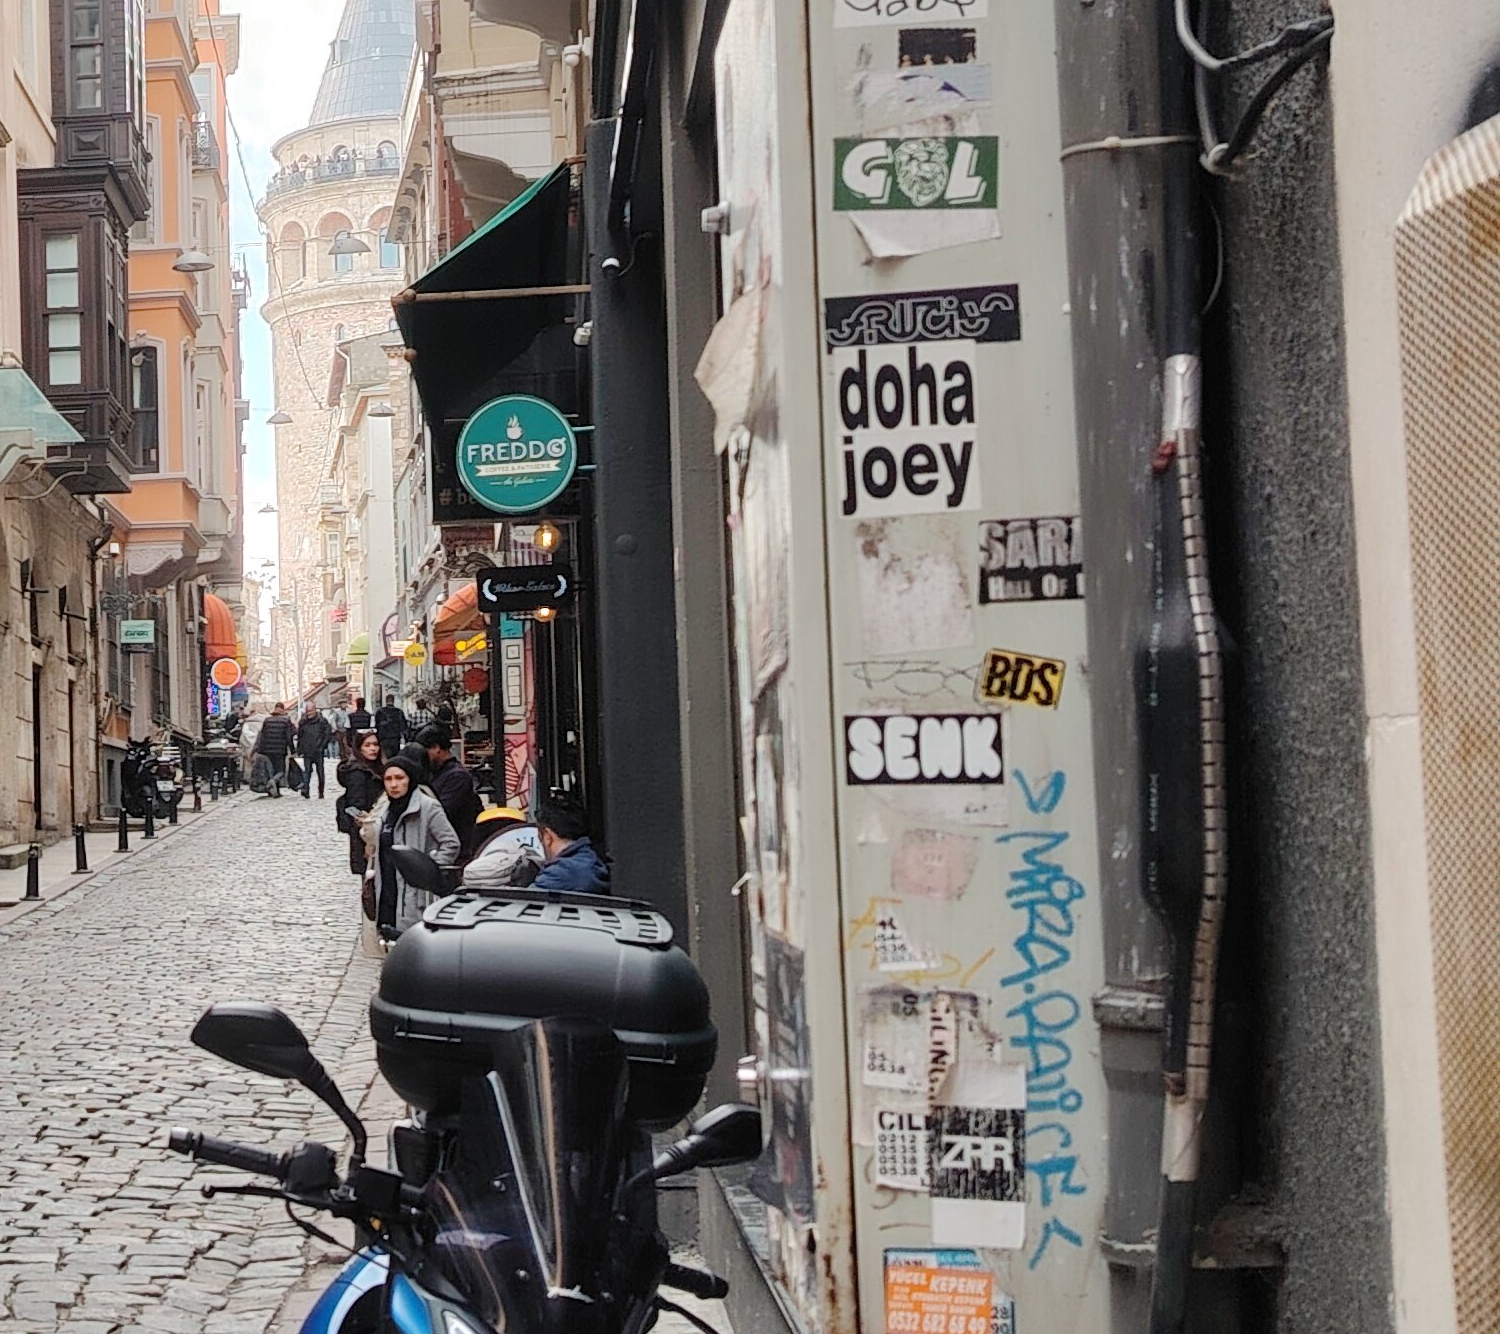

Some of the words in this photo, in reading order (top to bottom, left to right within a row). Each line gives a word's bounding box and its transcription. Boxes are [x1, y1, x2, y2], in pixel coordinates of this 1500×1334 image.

[839, 346, 975, 430] doha
[467, 436, 567, 464] FREDDO
[842, 435, 974, 516] joey
[929, 1274, 988, 1295] KEPENK
